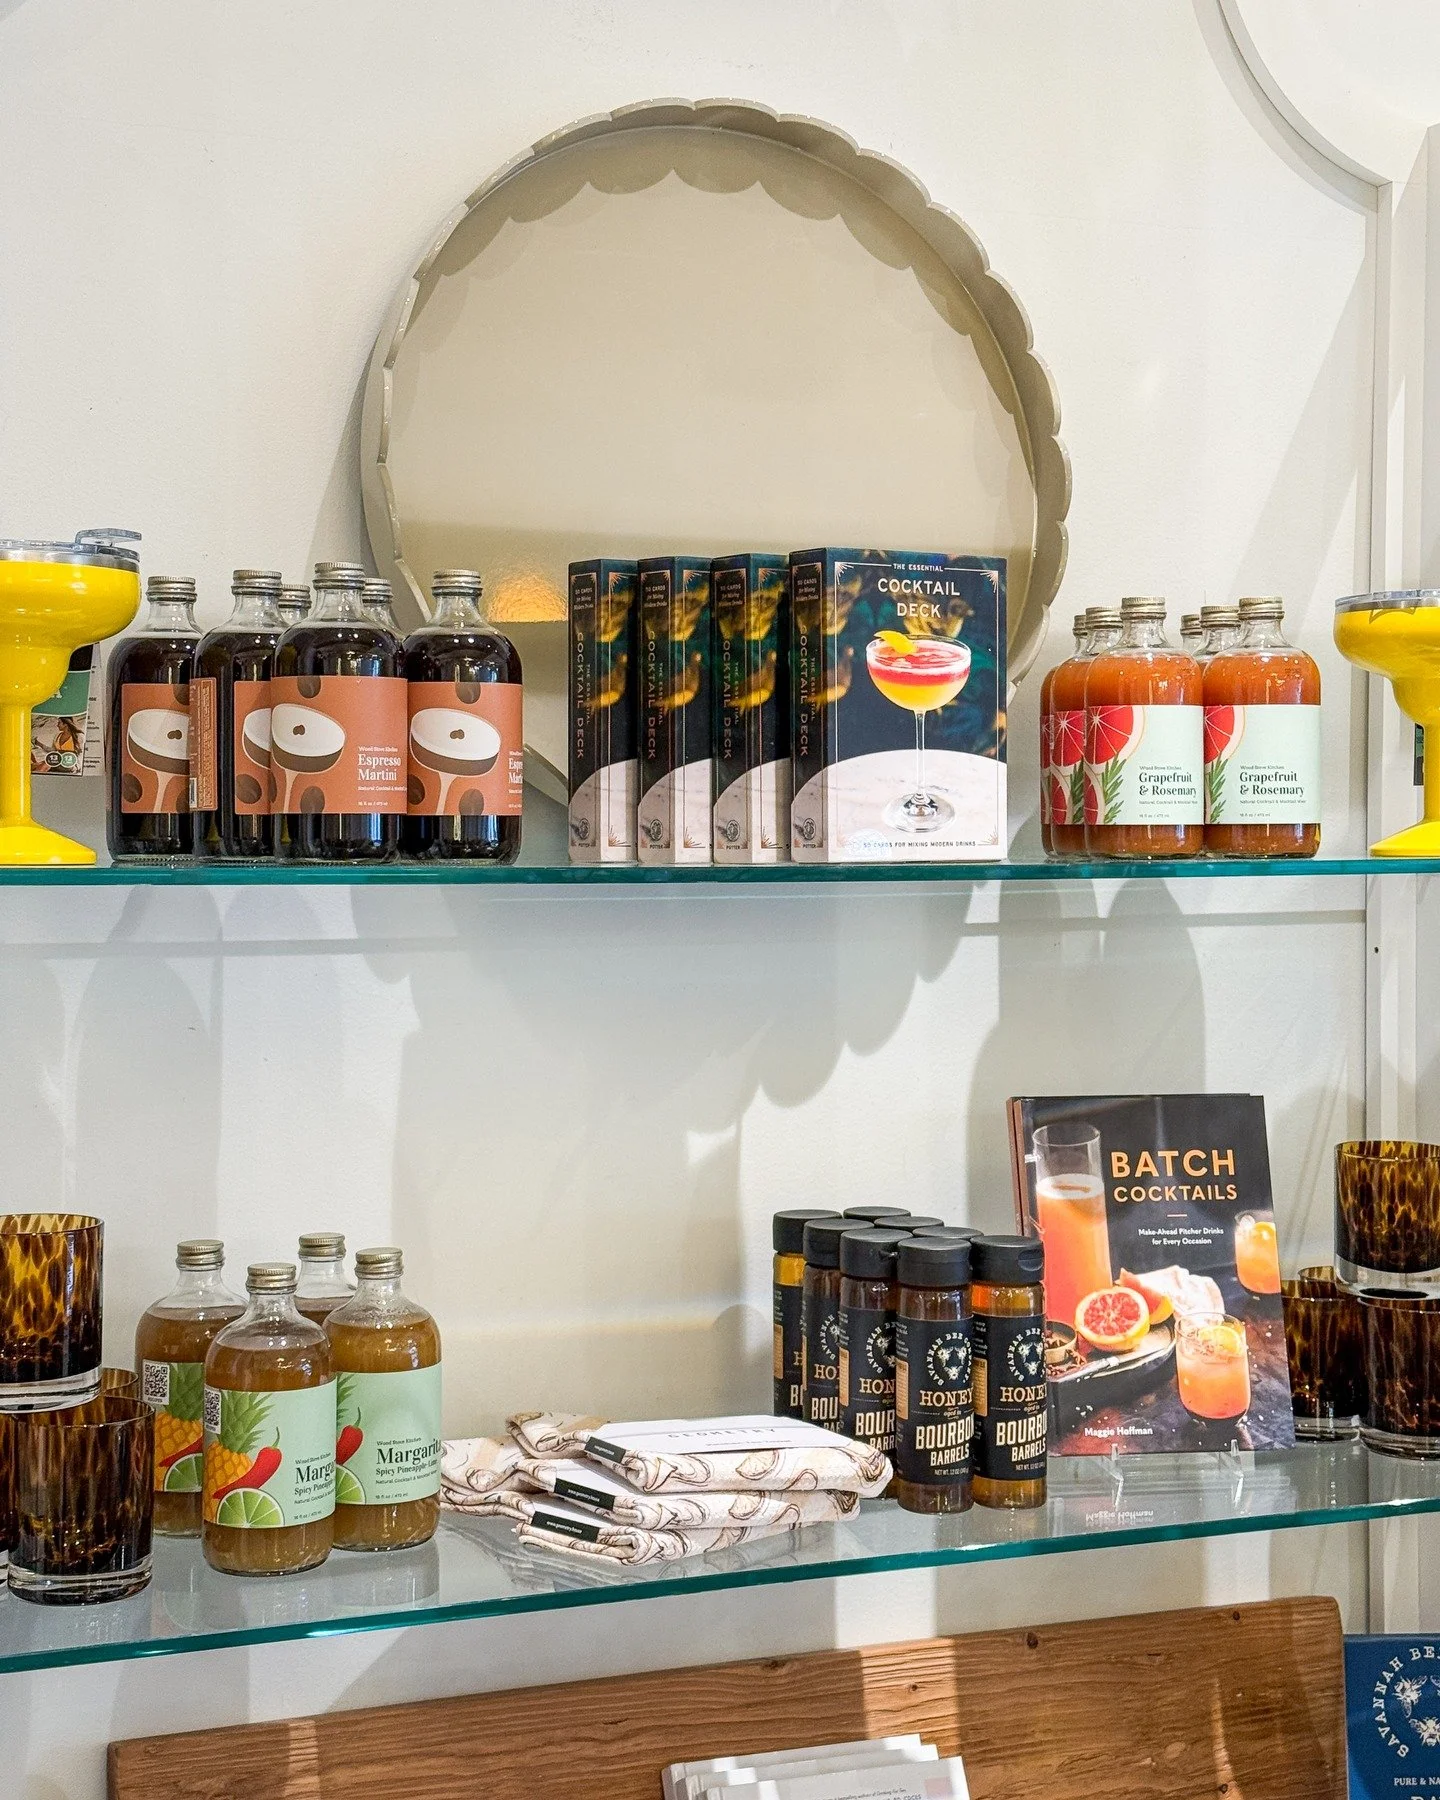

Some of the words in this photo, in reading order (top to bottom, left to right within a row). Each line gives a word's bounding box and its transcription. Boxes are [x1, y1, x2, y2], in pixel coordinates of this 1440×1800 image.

[908, 564, 943, 572] ESSENTIAL
[878, 578, 960, 596] COCKTAIL
[897, 602, 941, 618] DECK
[358, 754, 401, 769] Espresso
[358, 768, 398, 781] Martini
[1139, 772, 1192, 785] Grapefruit
[1240, 771, 1298, 784] Grapefruit
[1139, 785, 1149, 796] &
[1152, 785, 1196, 798] Rosemary
[1240, 785, 1249, 795] &
[1252, 784, 1305, 797] Rosemary
[1111, 1149, 1235, 1178] BATCH
[1114, 1184, 1237, 1202] COCKTAILS
[1163, 1238, 1180, 1246] Every
[1025, 1328, 1041, 1337] BEE
[927, 1338, 944, 1386] SAVANNAH
[945, 1332, 963, 1340] BEE
[860, 1378, 895, 1394] HON
[855, 1409, 895, 1436] BOUR
[1084, 1428, 1115, 1438] Maggie
[1117, 1426, 1153, 1435] Hoffman
[870, 1435, 895, 1451] BARR
[1012, 1437, 1046, 1462] BARRELS
[930, 1443, 970, 1466] BARRELS
[376, 1468, 394, 1477] Spicy
[294, 1487, 312, 1496] Spicy
[1373, 1656, 1409, 1757] SAVANNAH
[1409, 1646, 1440, 1660] BE
[1394, 1777, 1417, 1786] PURE
